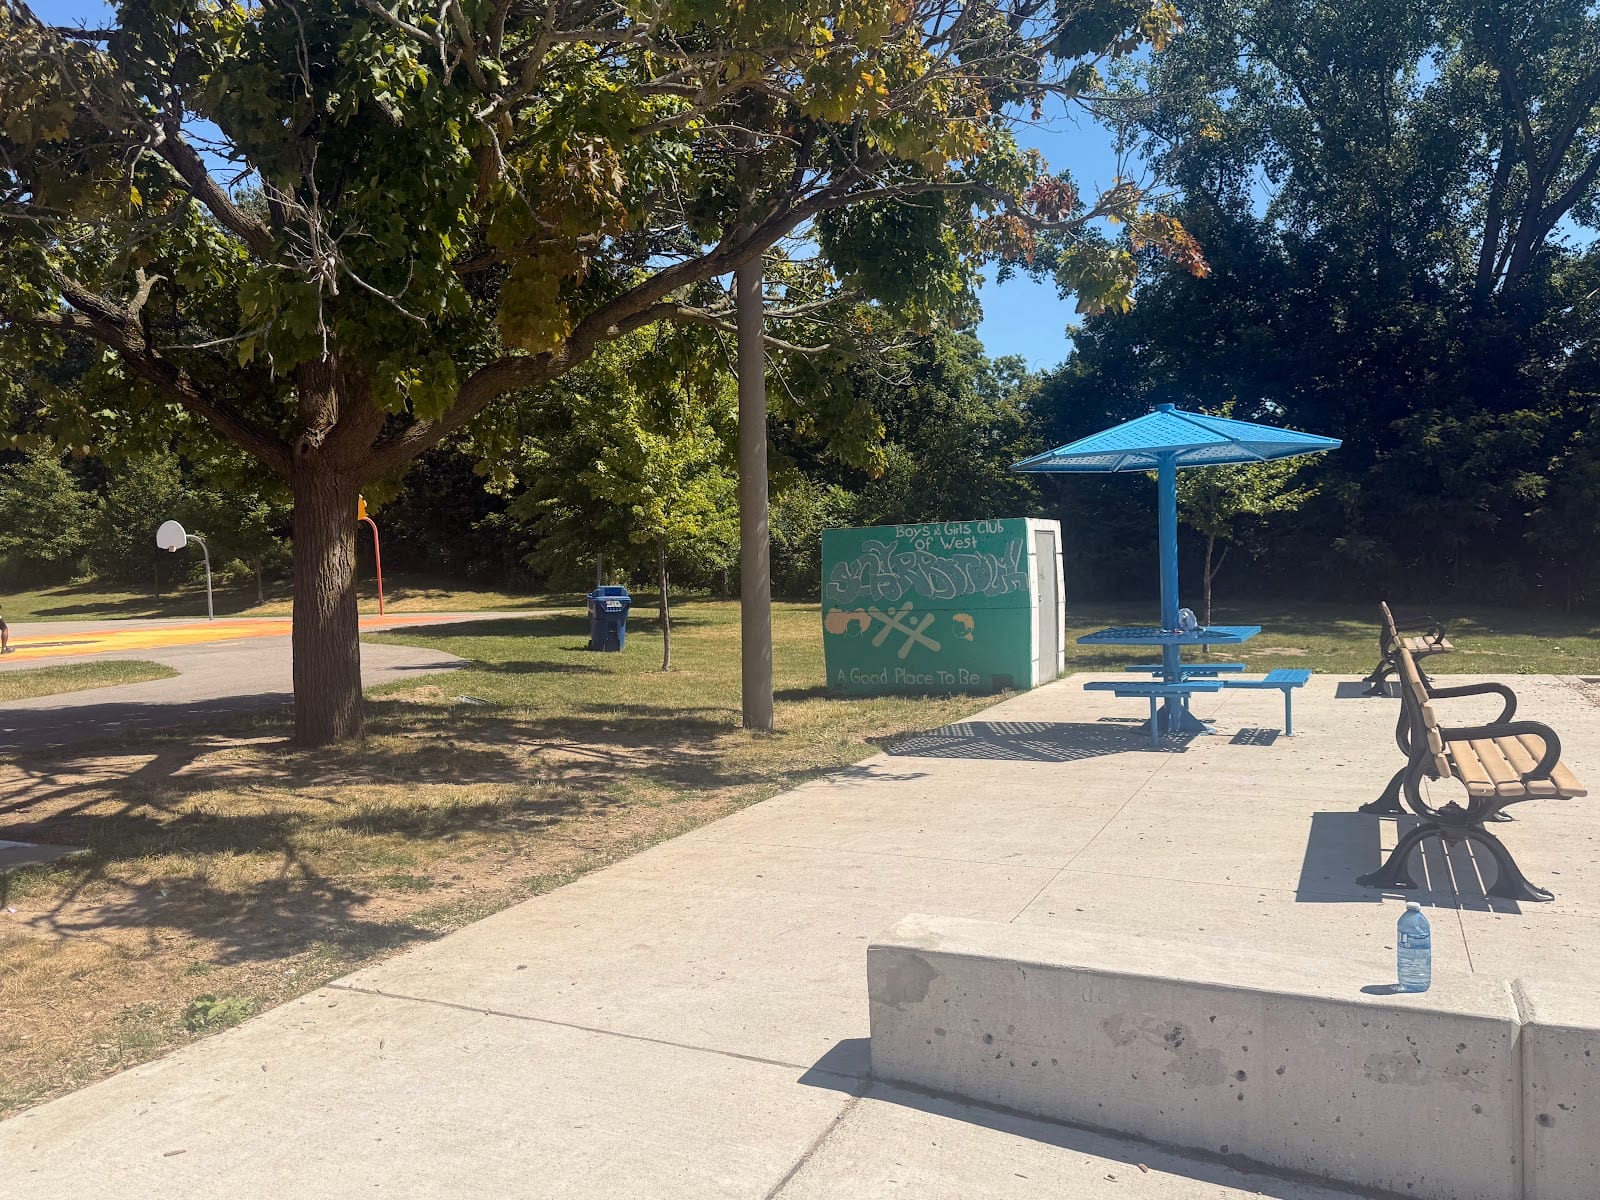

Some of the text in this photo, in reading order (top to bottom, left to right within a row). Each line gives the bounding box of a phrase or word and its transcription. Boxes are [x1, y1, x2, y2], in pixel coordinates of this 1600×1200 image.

[895, 520, 1004, 543] Boys & Girls Club
[940, 536, 979, 550] West
[836, 667, 981, 685] A Good Place To Be
